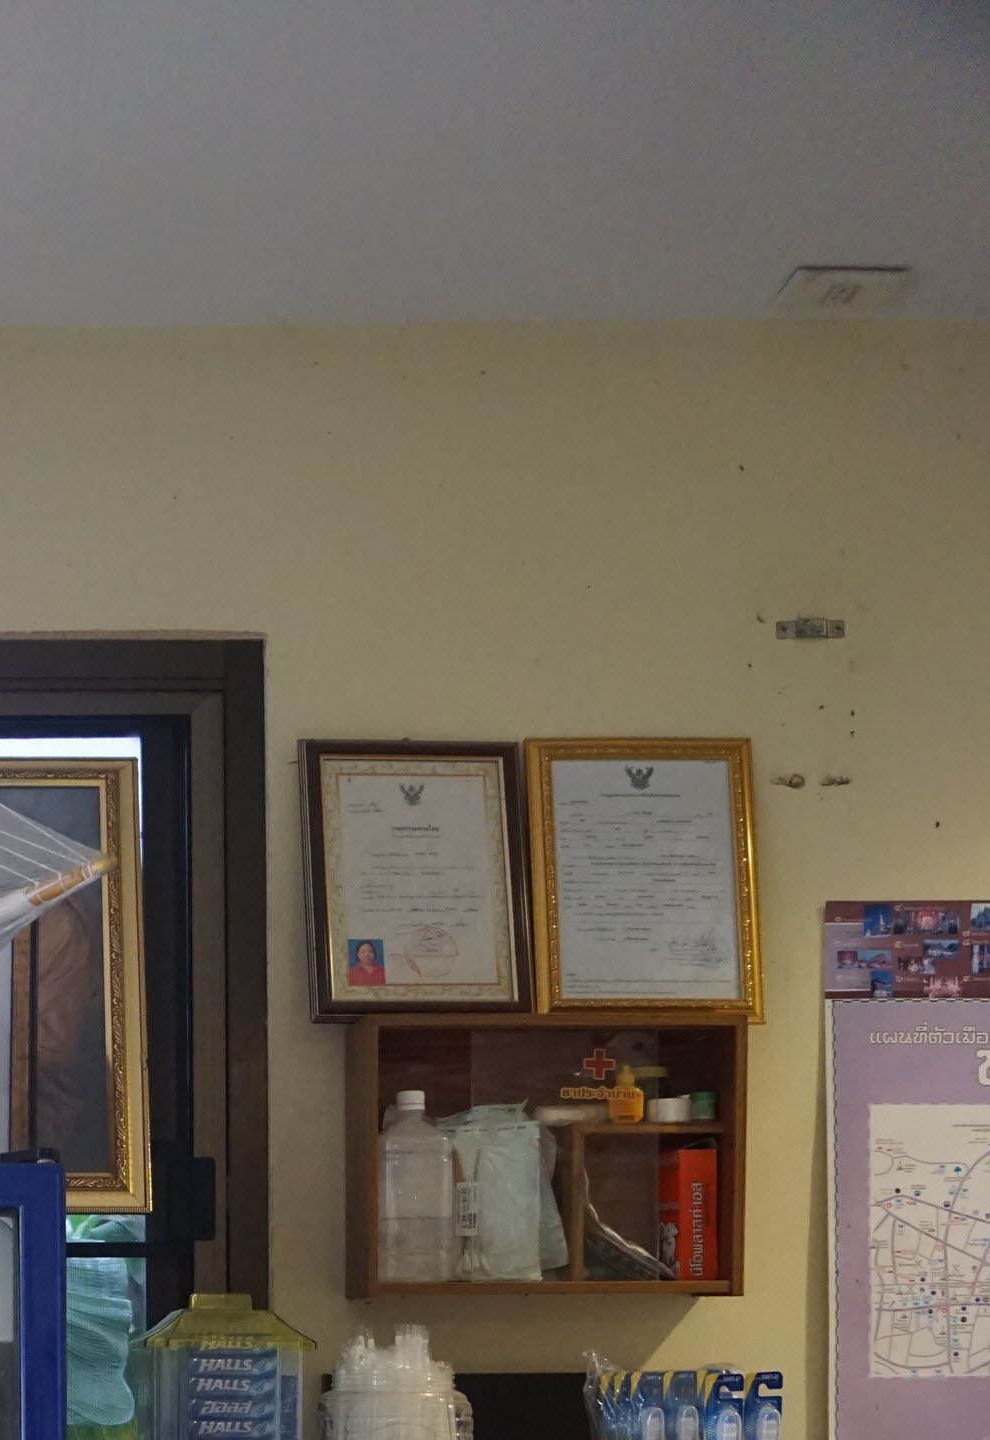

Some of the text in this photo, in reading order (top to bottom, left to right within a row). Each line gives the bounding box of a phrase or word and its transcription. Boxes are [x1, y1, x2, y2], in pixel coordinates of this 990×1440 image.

[870, 1022, 990, 1044] แผนที่ตัวเมือ
[198, 1359, 253, 1373] HALLS
[196, 1378, 251, 1391] HALLS
[198, 1421, 252, 1434] HALLS
